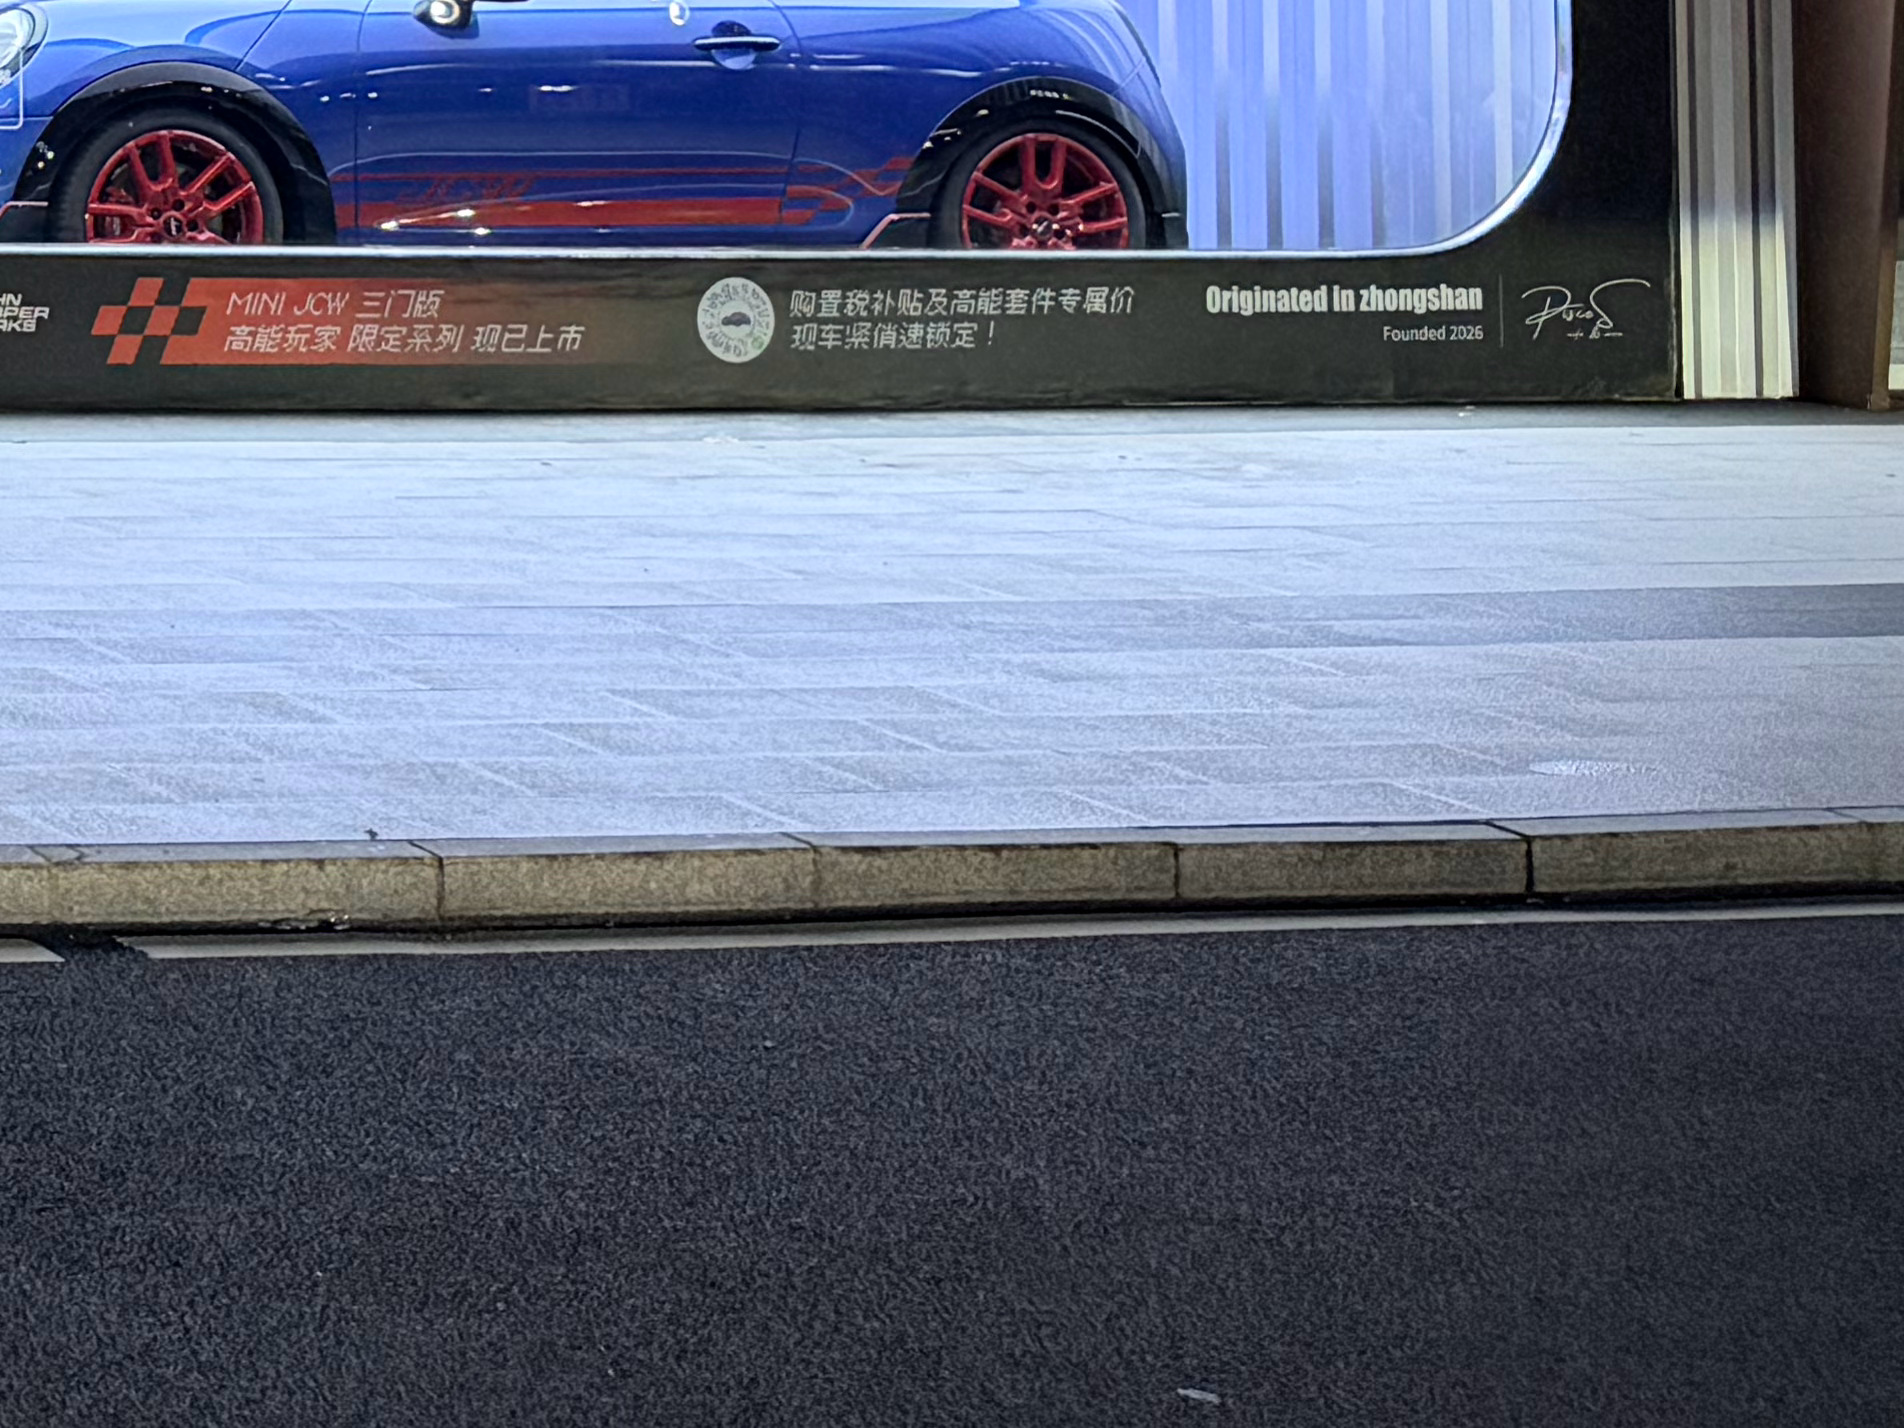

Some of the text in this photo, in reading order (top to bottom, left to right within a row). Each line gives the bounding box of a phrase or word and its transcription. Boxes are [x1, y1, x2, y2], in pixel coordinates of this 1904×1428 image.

[226, 289, 445, 318] MINI JCW 三门版
[790, 286, 1135, 317] 购置税补贴及高能套件专属价
[1206, 285, 1328, 314] Originated
[1360, 284, 1483, 316] zhongshan
[224, 324, 585, 353] 高能玩家 限定系列 现已上市
[1383, 325, 1483, 341] Founded 2026
